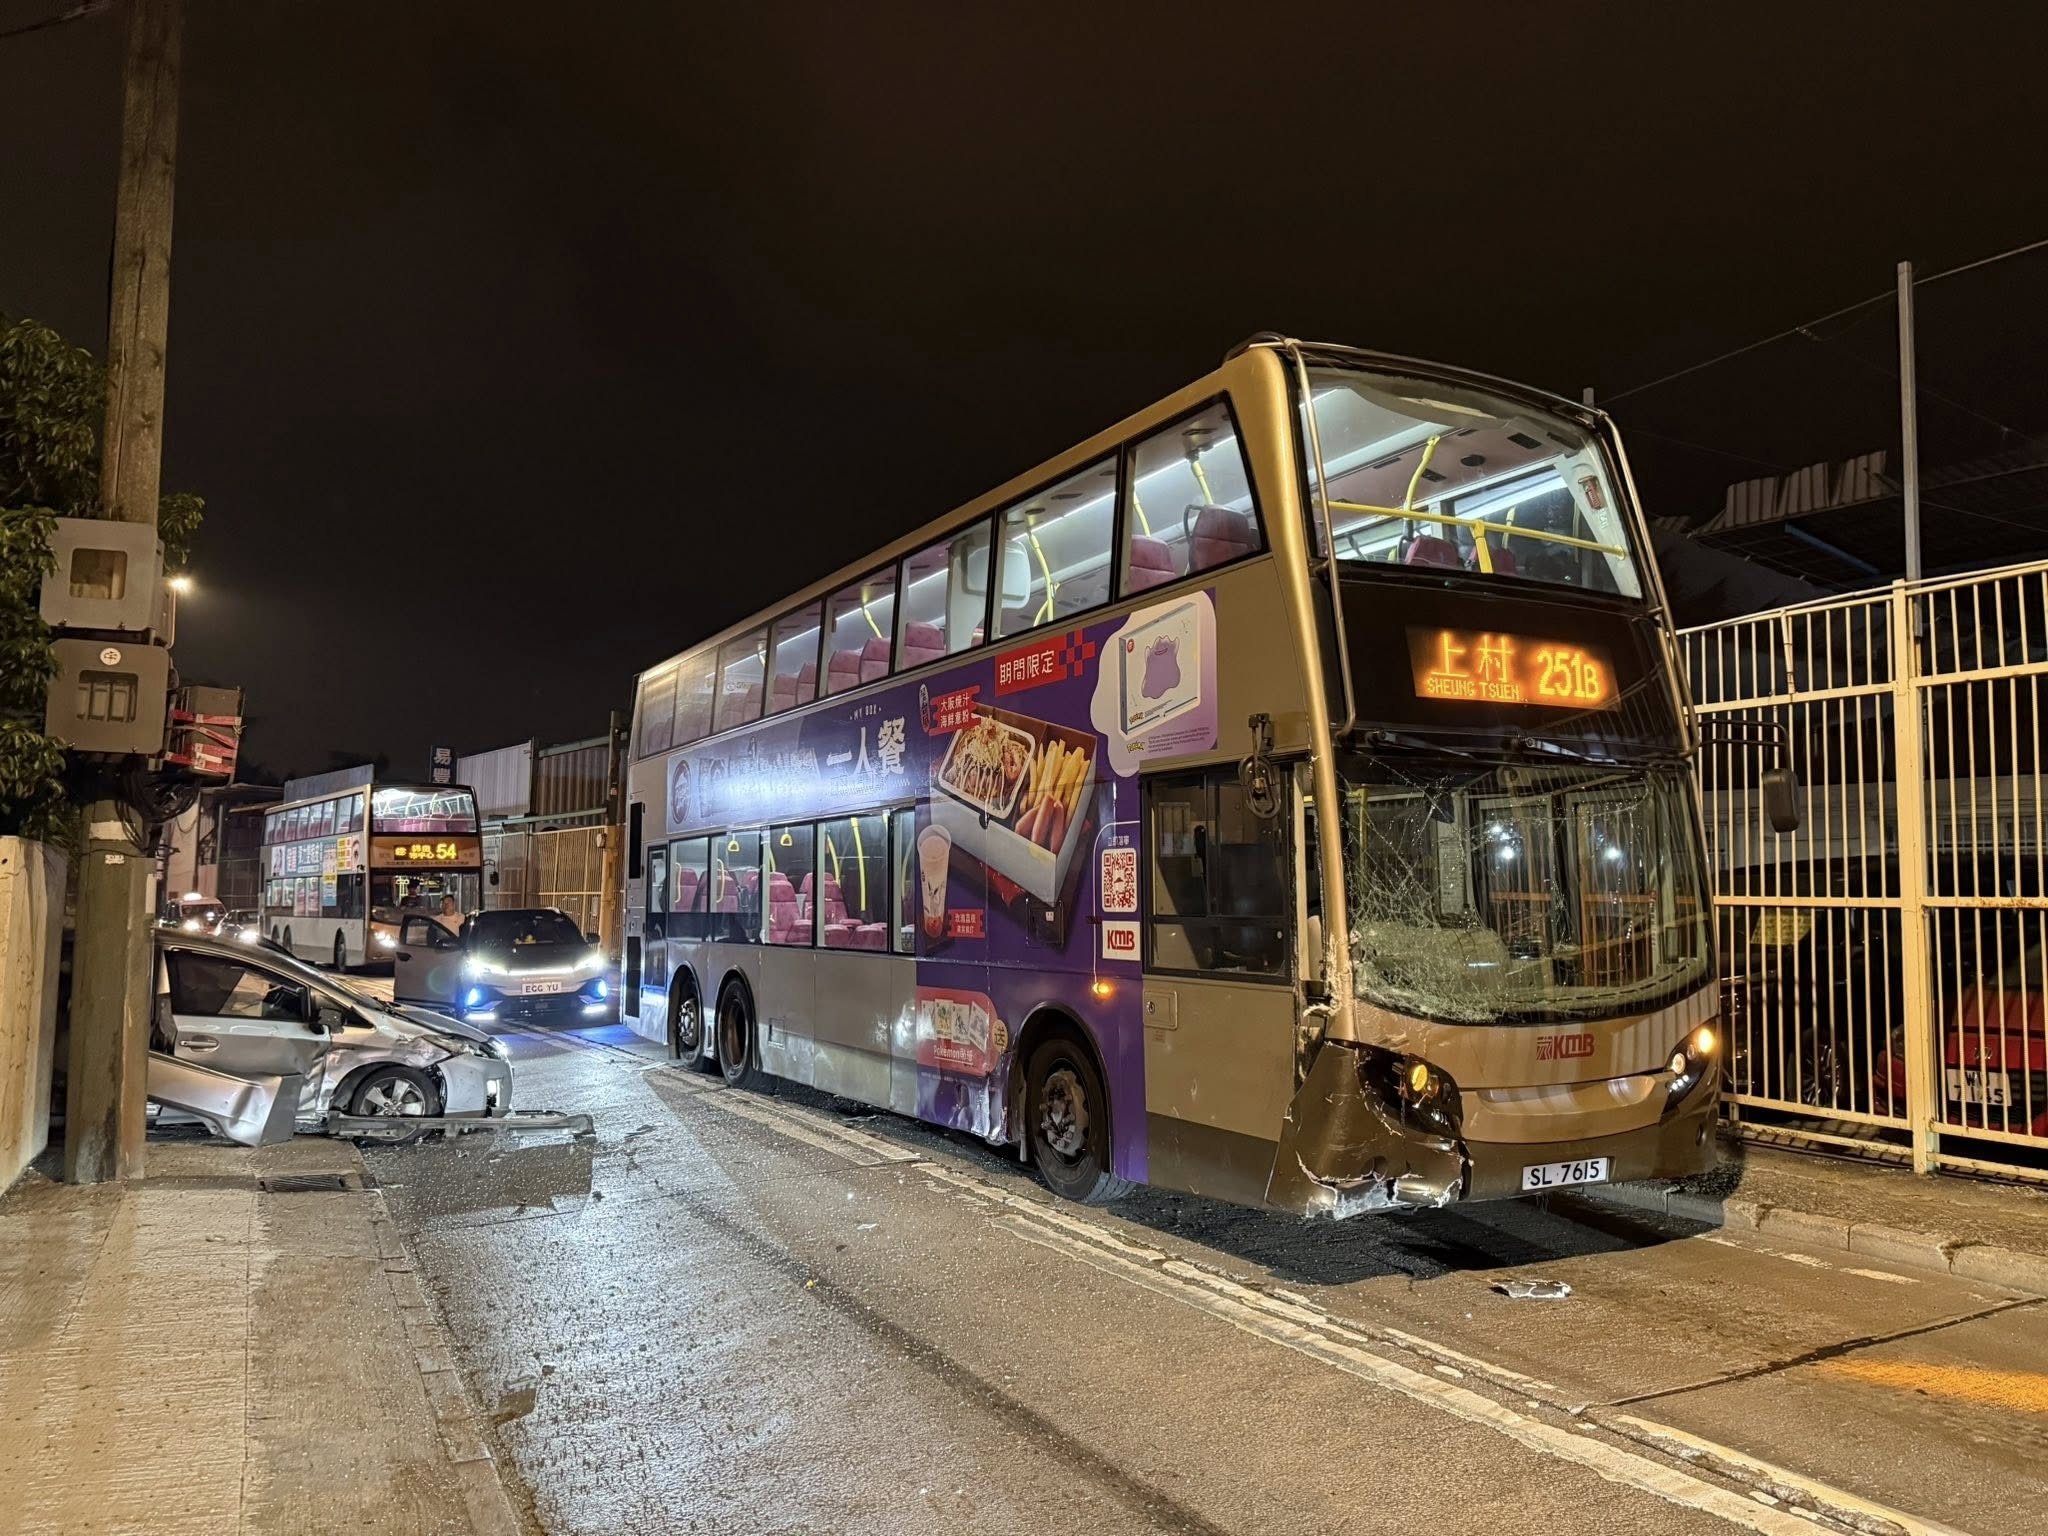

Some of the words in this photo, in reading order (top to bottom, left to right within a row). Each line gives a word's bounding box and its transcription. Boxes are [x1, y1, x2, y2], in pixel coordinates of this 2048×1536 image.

[999, 650, 1055, 686] 期間限定
[1430, 632, 1514, 683] 上村
[1537, 650, 1600, 699] 251B
[1427, 677, 1475, 697] SHEUNG
[1479, 681, 1520, 700] TSUEN
[826, 716, 906, 777] 一人餐
[436, 843, 457, 859] 54
[1107, 929, 1135, 951] KMB
[525, 984, 544, 993] EGG
[547, 983, 559, 991] YU
[1553, 1033, 1594, 1060] KMB
[1530, 1166, 1552, 1186] SL
[1561, 1160, 1600, 1183] 7615
